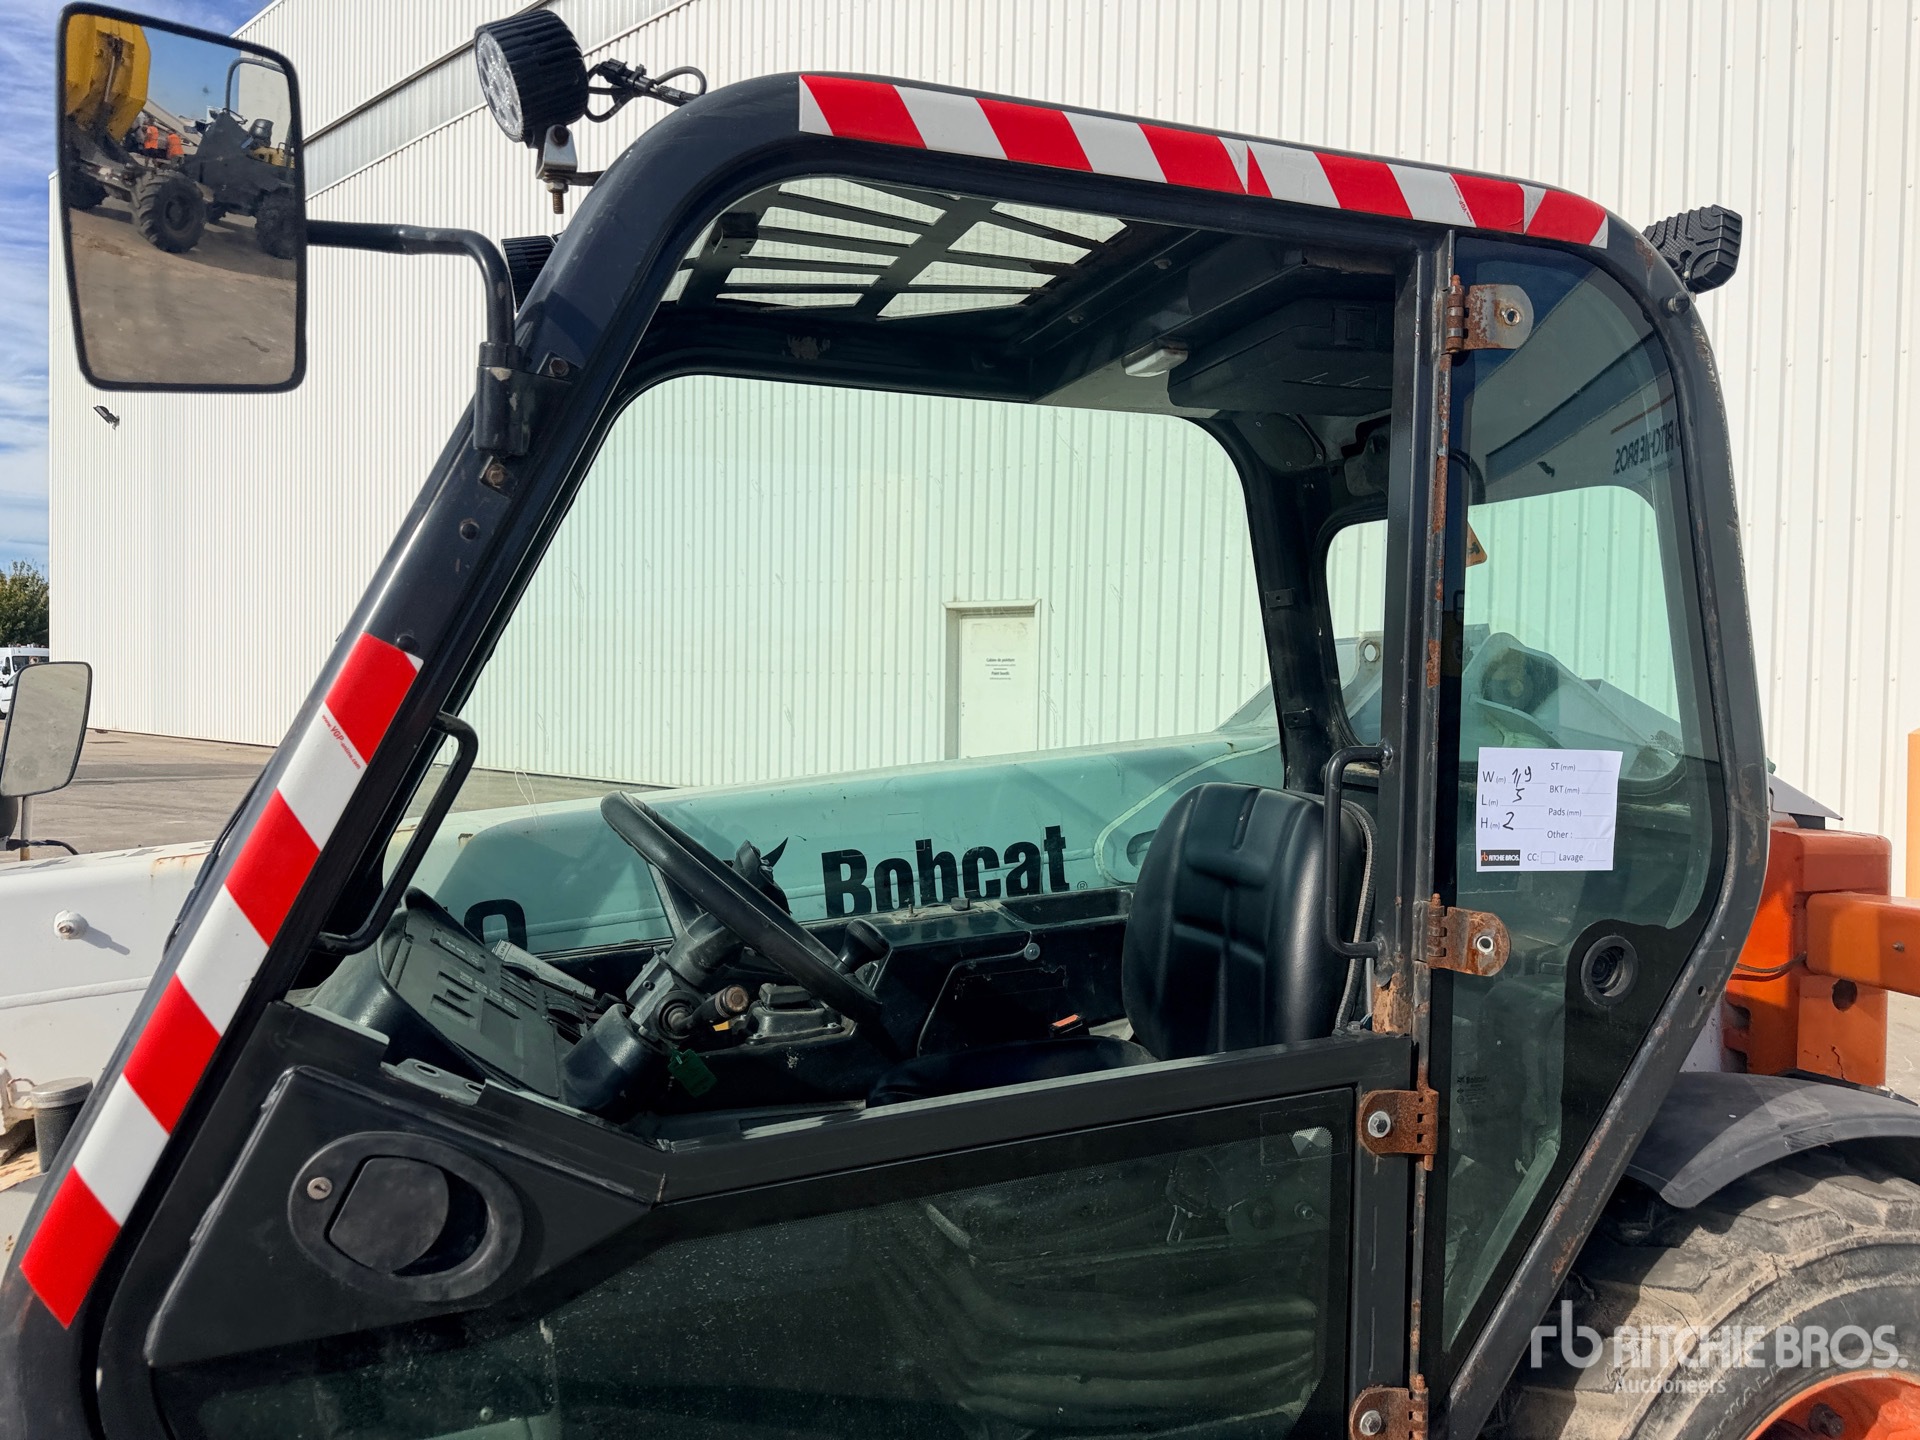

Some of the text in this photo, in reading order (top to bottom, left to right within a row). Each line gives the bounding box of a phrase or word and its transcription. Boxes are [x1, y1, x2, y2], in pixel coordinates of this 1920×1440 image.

[1550, 762, 1560, 771] ST
[1482, 771, 1495, 783] W
[1549, 785, 1564, 793] BKT
[1481, 794, 1488, 806] L
[1548, 808, 1566, 816] Pads
[1480, 817, 1489, 829] H
[1502, 811, 1515, 831] 2
[1558, 853, 1584, 862] Lavage
[821, 825, 1070, 919] Bobcat
